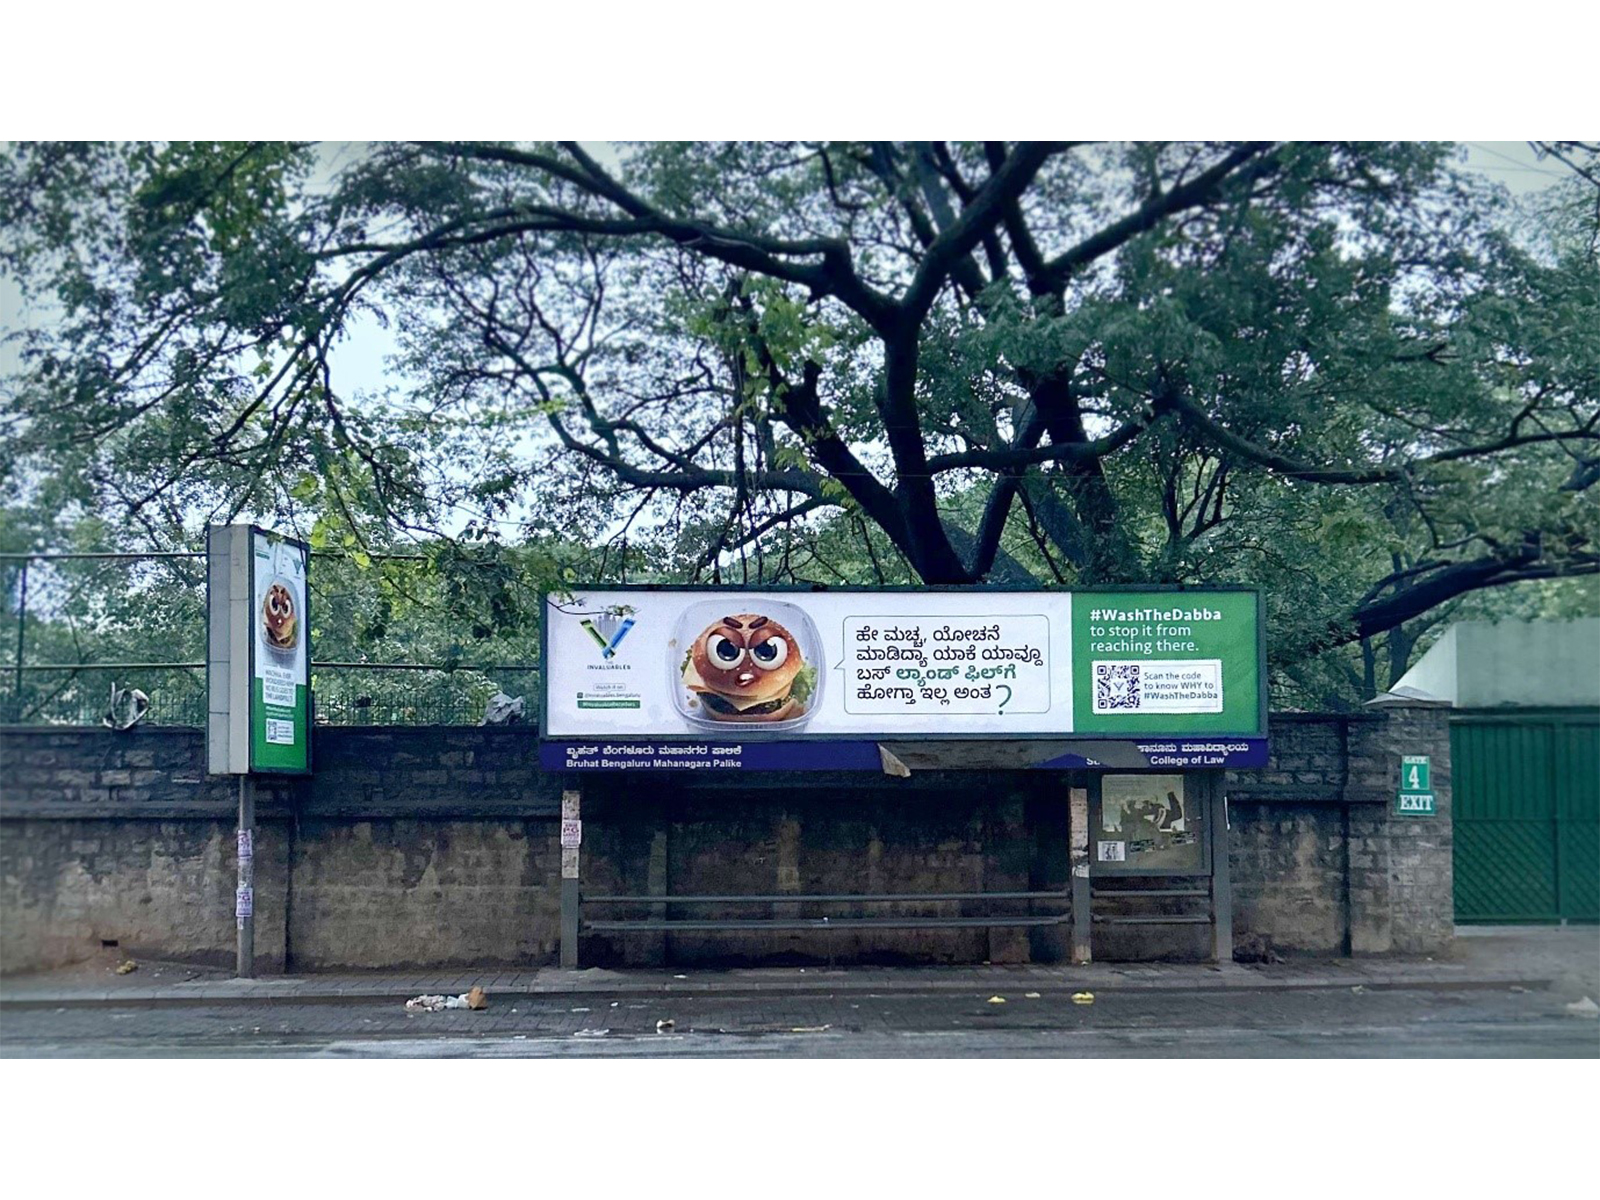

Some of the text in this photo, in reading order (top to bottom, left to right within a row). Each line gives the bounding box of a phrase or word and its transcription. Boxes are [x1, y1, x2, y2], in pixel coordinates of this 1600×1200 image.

[1090, 608, 1222, 621] #WashTheDabba
[856, 625, 1000, 648] ಹೇ ಮಚ್ಚ, ಯೋಚನೆ
[1090, 624, 1191, 639] to stop it from
[1090, 639, 1199, 654] reaching there.
[857, 644, 1043, 667] ಮಾಡಿದ್ಯಾ ಯಾಕೆ ಯಾವ್ದೂ
[857, 666, 891, 680] ಬಸ್
[896, 665, 959, 687] ಲ್ಯಾಂಡ್
[1144, 671, 1202, 680] Scan the code
[1144, 682, 1153, 690] to
[1156, 682, 1178, 690] know
[857, 684, 916, 705] ಹೋಗ್ತಾ
[920, 687, 950, 705] ಇಲ್ಲ
[1144, 692, 1218, 700] #WashTheDabba
[566, 760, 742, 769] Bruhat Bengaluru Mahanagara Palike
[1150, 756, 1188, 766] College
[1191, 755, 1201, 765] of
[1204, 755, 1225, 764] Law
[1408, 765, 1419, 789] 4
[1400, 794, 1433, 810] EXIT
